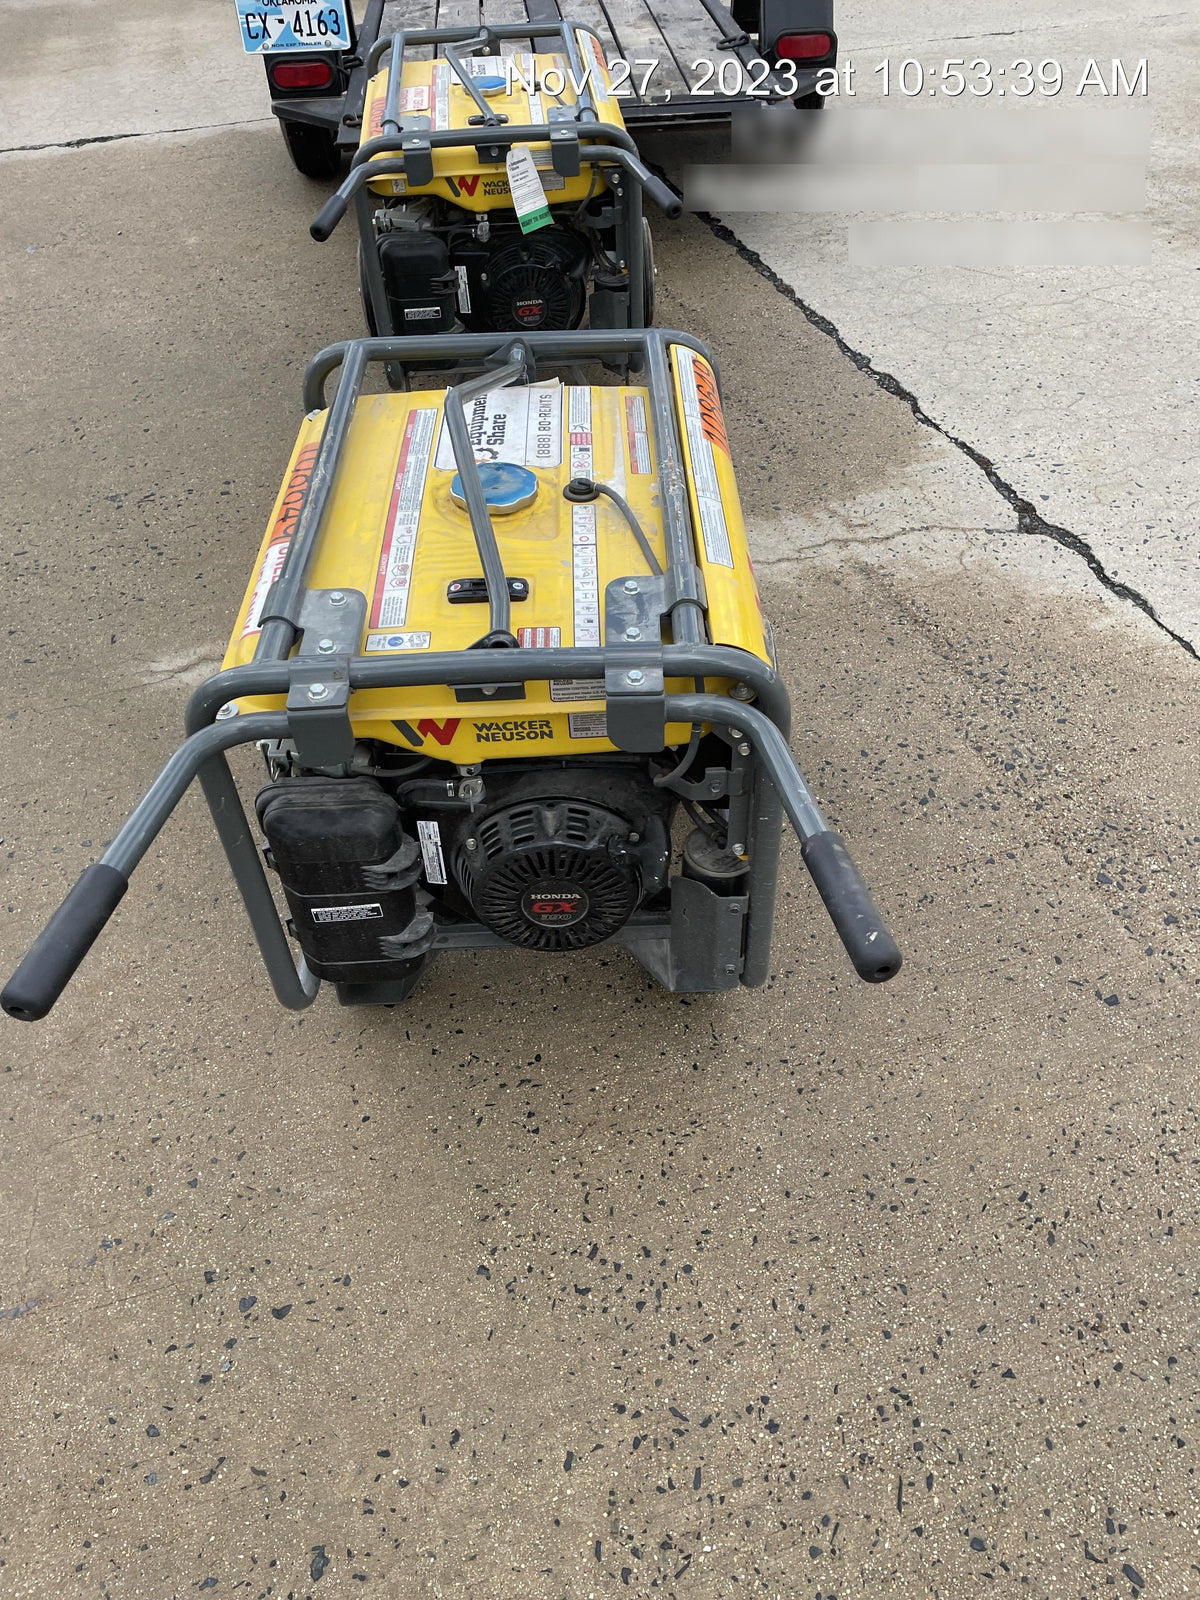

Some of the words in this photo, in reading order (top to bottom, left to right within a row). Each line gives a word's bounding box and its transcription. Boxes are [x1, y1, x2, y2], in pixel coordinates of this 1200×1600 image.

[245, 12, 272, 39] CX
[293, 9, 341, 37] 4163
[482, 180, 511, 189] WACK
[483, 188, 512, 196] NEUS
[486, 413, 507, 446] Share
[535, 434, 552, 459] (888)
[472, 720, 553, 733] WACKER
[475, 730, 554, 743] NEUSON
[532, 901, 579, 913] GX
